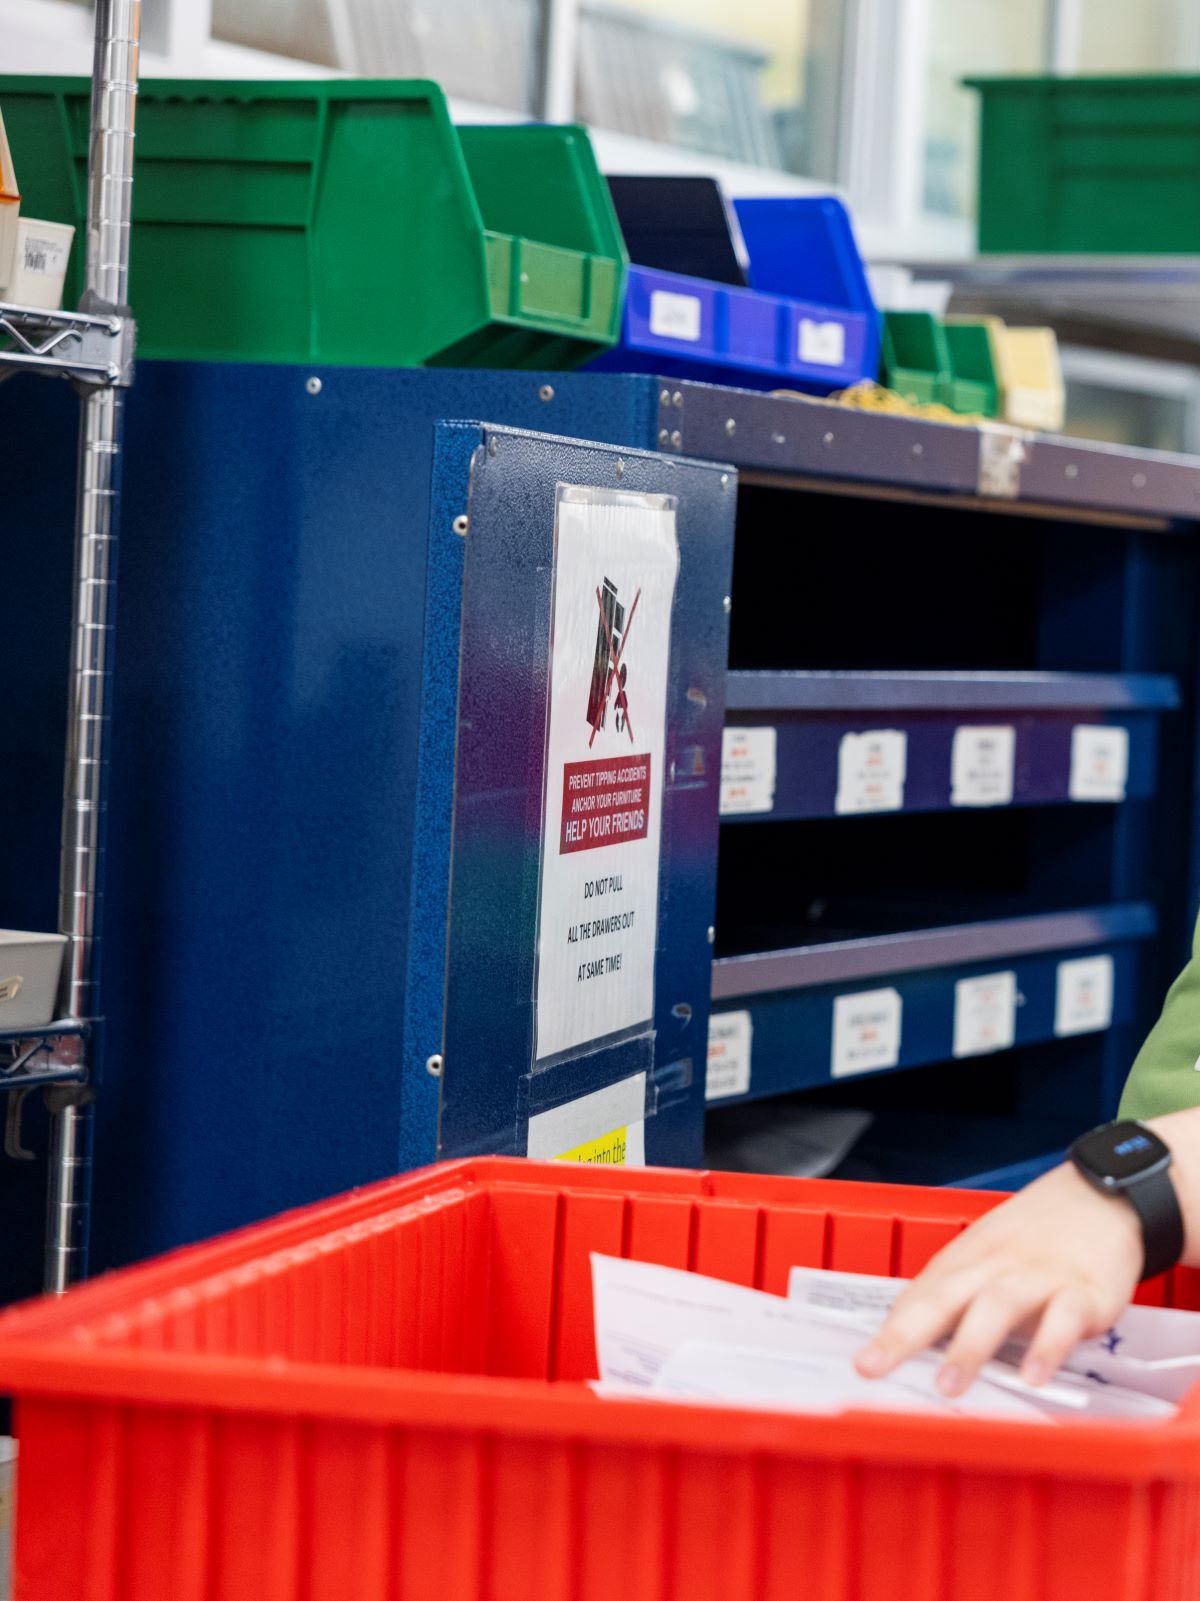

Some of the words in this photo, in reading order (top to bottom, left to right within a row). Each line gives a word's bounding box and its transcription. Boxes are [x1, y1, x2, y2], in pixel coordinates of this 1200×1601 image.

[569, 773, 595, 790] PREVENT
[596, 770, 617, 786] TIPPING
[618, 766, 647, 782] ACCIDENTS
[571, 796, 596, 813] ANCHOR
[597, 793, 611, 808] YOUR
[612, 788, 642, 806] FURNITURE
[565, 819, 587, 842] HELP
[589, 815, 610, 838] YOUR
[612, 809, 644, 834] FRIENDS
[584, 881, 594, 899] DO
[595, 878, 608, 896] NOT
[609, 875, 623, 893] PULL
[567, 926, 578, 944] ALL
[580, 922, 591, 940] THE
[592, 914, 622, 938] DRAWERS
[622, 911, 635, 929] OUT
[577, 964, 586, 982] AT
[587, 959, 604, 979] SAME
[605, 953, 622, 973] TIME!
[613, 1137, 626, 1163] the
